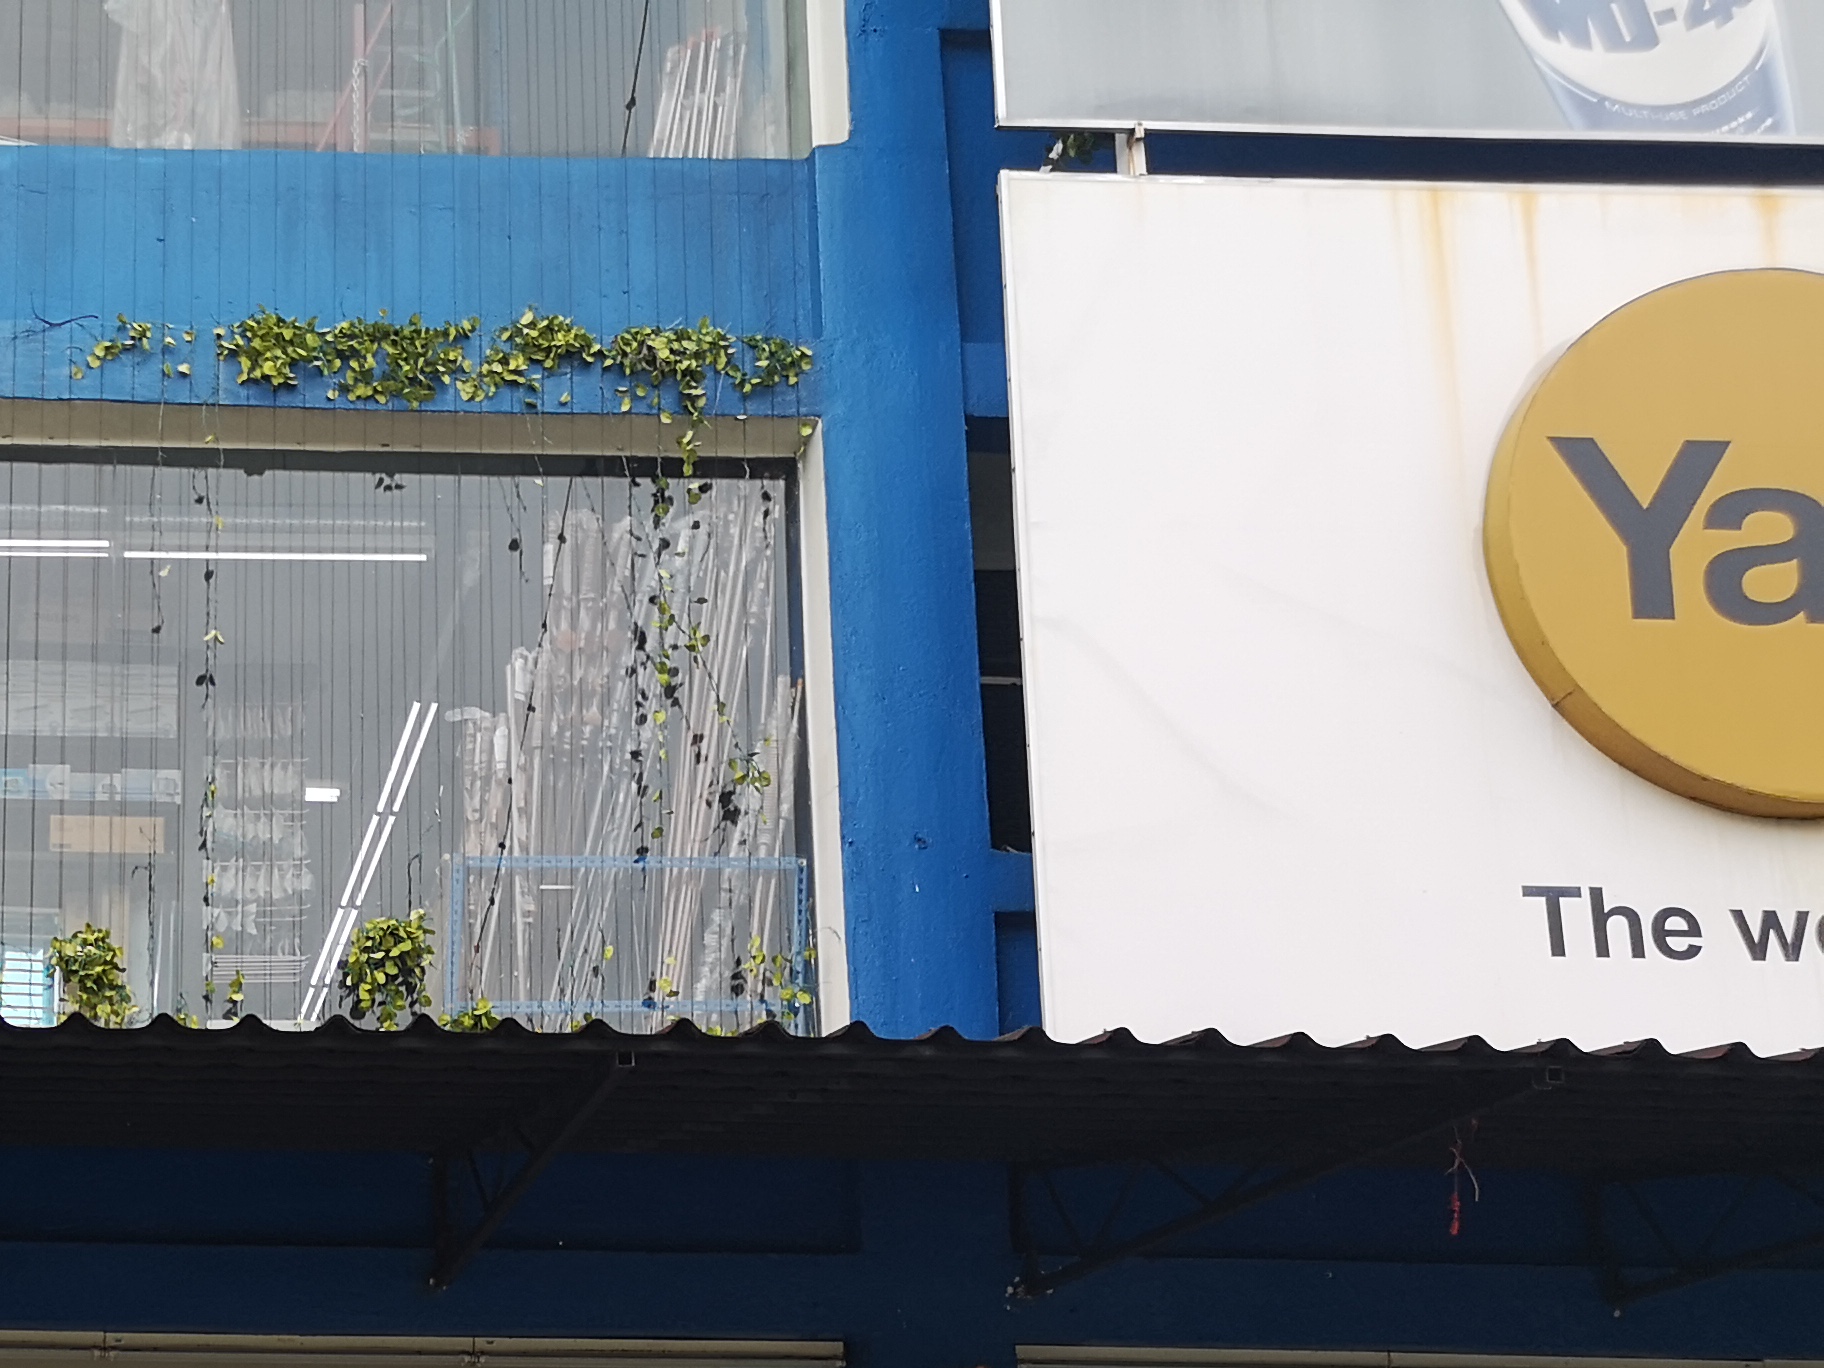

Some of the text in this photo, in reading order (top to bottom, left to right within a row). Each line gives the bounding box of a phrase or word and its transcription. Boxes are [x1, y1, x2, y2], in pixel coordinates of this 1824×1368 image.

[1521, 0, 1753, 53] WD-4
[1692, 76, 1754, 116] PRODUCT
[1521, 885, 1824, 963] The w
